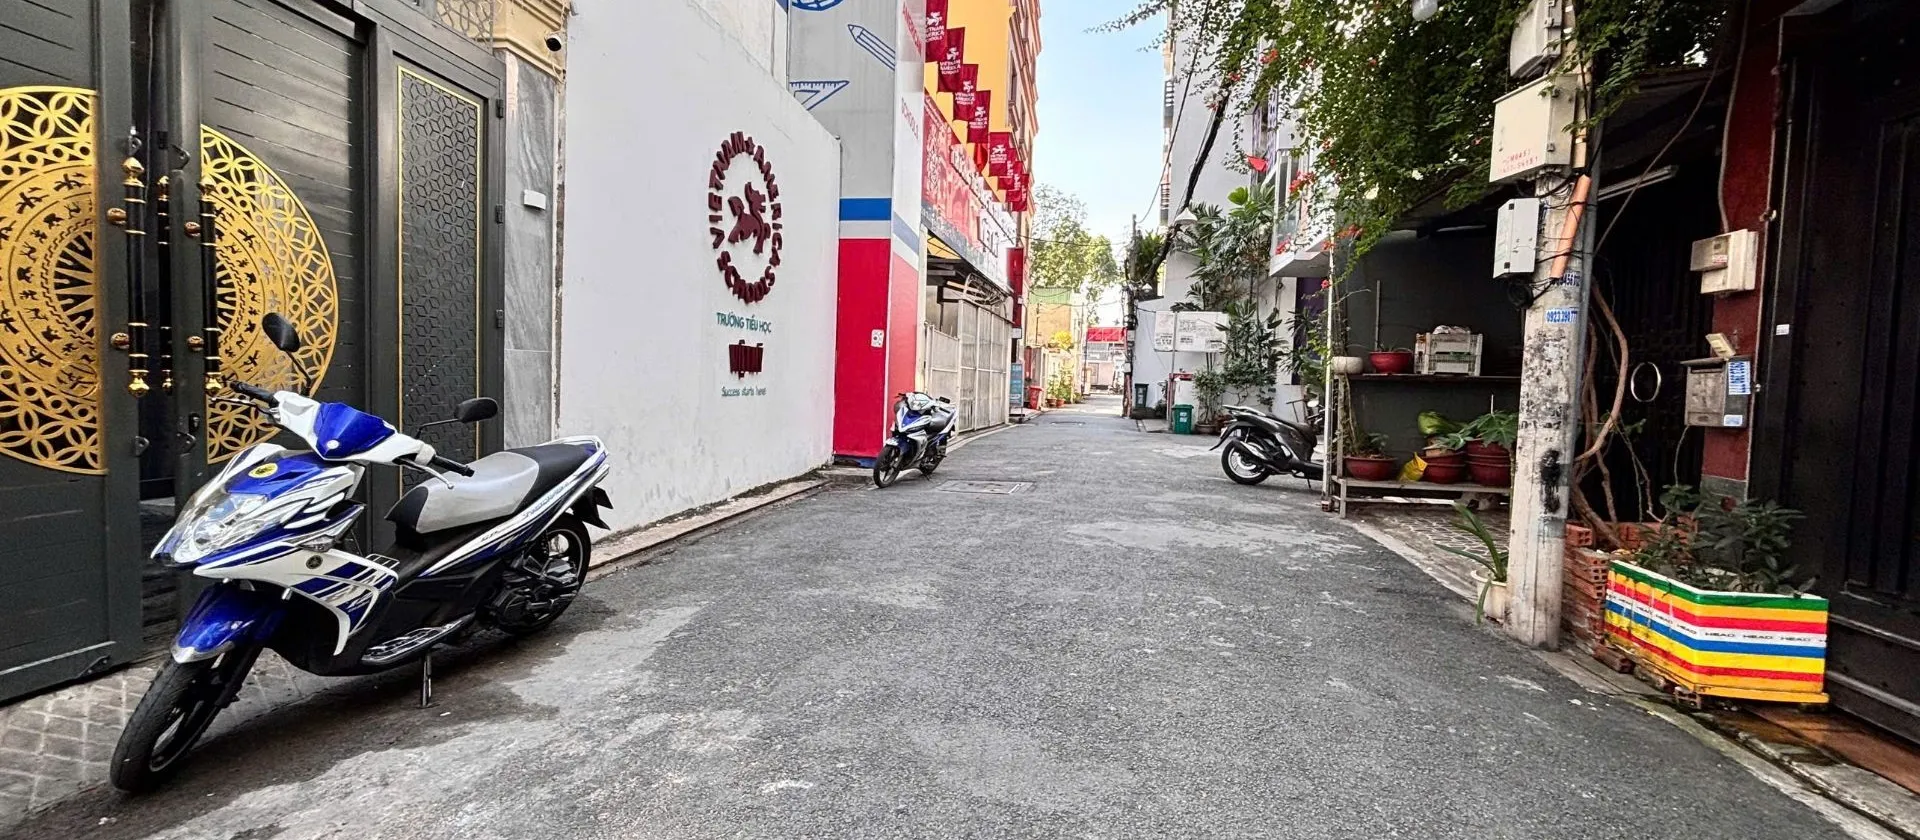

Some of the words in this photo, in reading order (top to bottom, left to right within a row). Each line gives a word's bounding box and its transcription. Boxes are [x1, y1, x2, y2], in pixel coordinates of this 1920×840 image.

[708, 131, 746, 249] VIETNAM
[753, 145, 782, 267] AMERICA
[717, 251, 775, 304] SCHOOLS
[759, 321, 771, 334] HỌC
[722, 387, 740, 397] Success
[756, 386, 766, 396] here
[1677, 624, 1697, 634] HEAD
